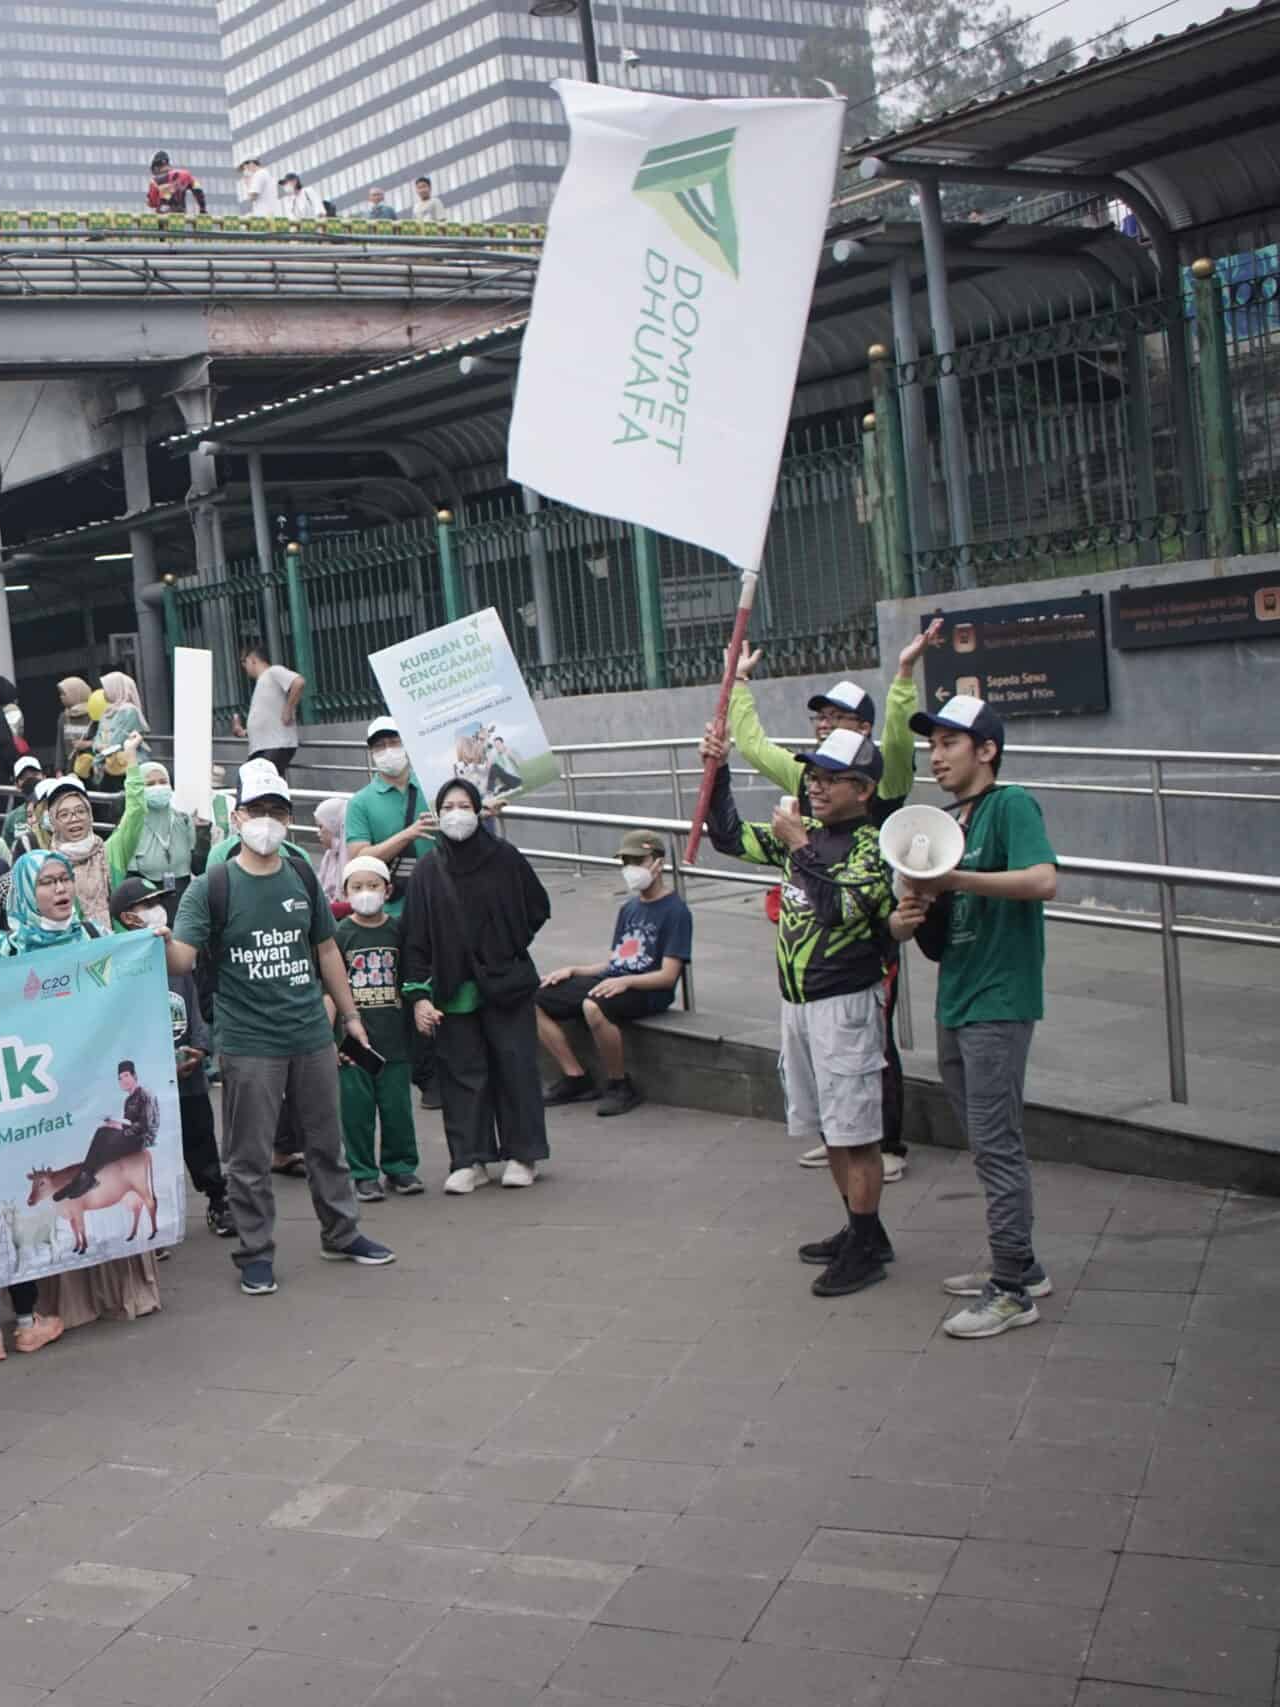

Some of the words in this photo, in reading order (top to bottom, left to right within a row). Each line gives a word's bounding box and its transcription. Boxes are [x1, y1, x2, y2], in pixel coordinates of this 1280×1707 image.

[613, 248, 669, 446] DHUAFA
[656, 267, 703, 464] DOMPET
[399, 638, 461, 672] KURBAN
[463, 631, 480, 647] DI
[399, 643, 493, 689] GENGGAMAN
[230, 945, 290, 964] Hewan
[252, 928, 301, 947] Tebar
[249, 959, 309, 980] Kurban
